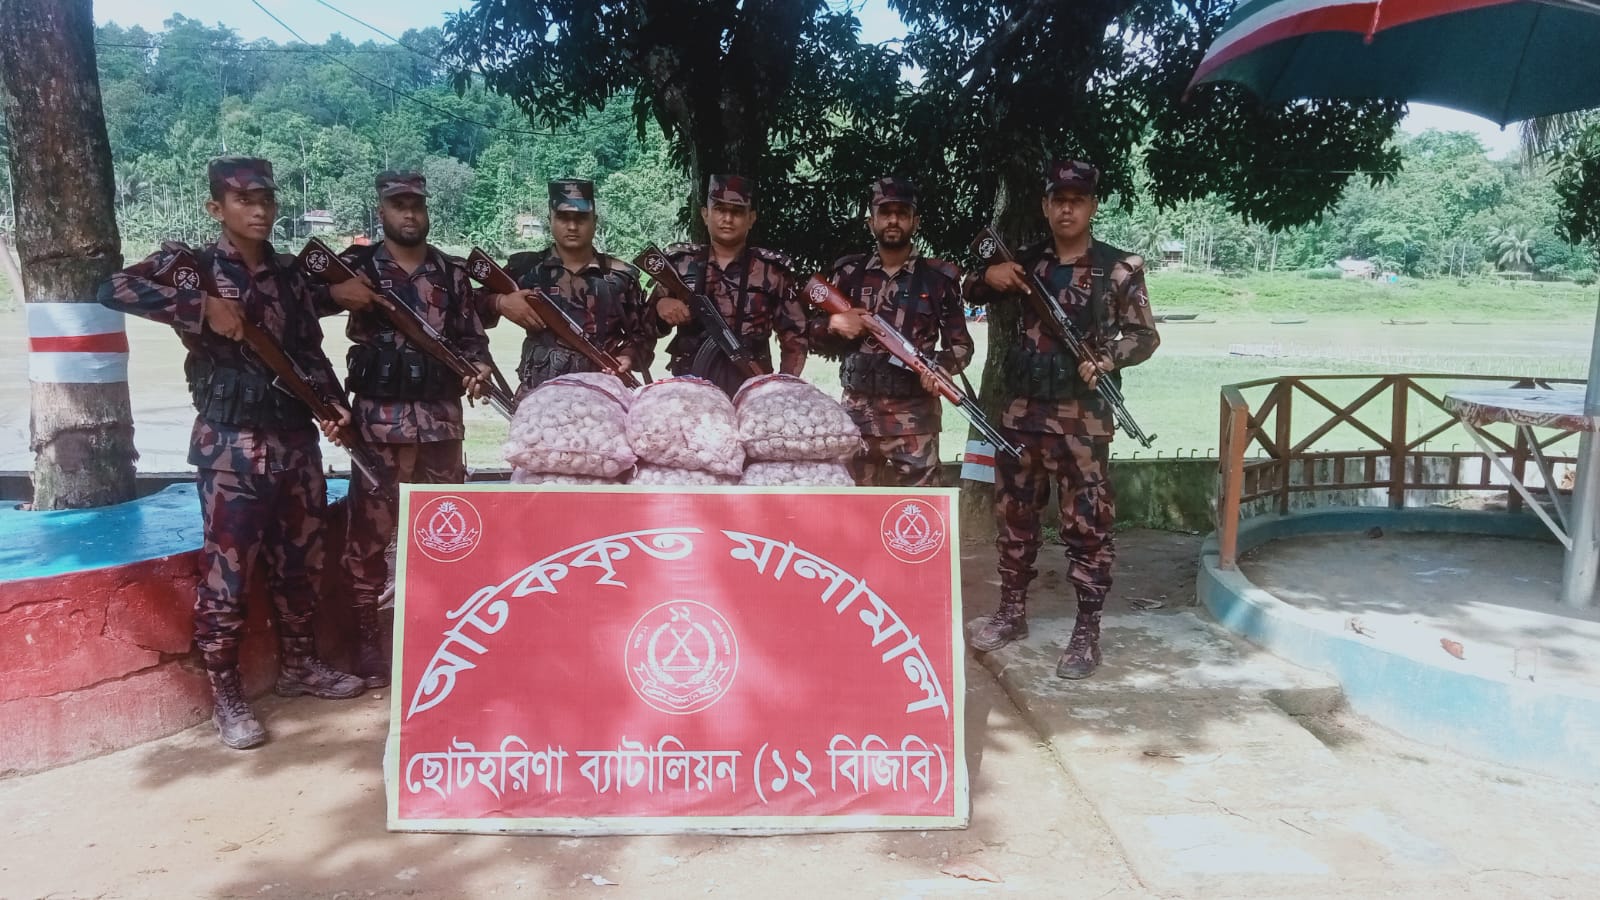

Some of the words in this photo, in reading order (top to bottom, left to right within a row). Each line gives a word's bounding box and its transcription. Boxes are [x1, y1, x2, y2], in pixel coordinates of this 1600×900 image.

[406, 527, 704, 721] আটককৃত
[720, 529, 949, 721] মালামাল
[405, 735, 568, 800] ছোটহরিণা
[576, 735, 742, 793] ব্যাটালিয়ন
[753, 742, 817, 804] (১২
[825, 734, 948, 804] বিজিবি)
